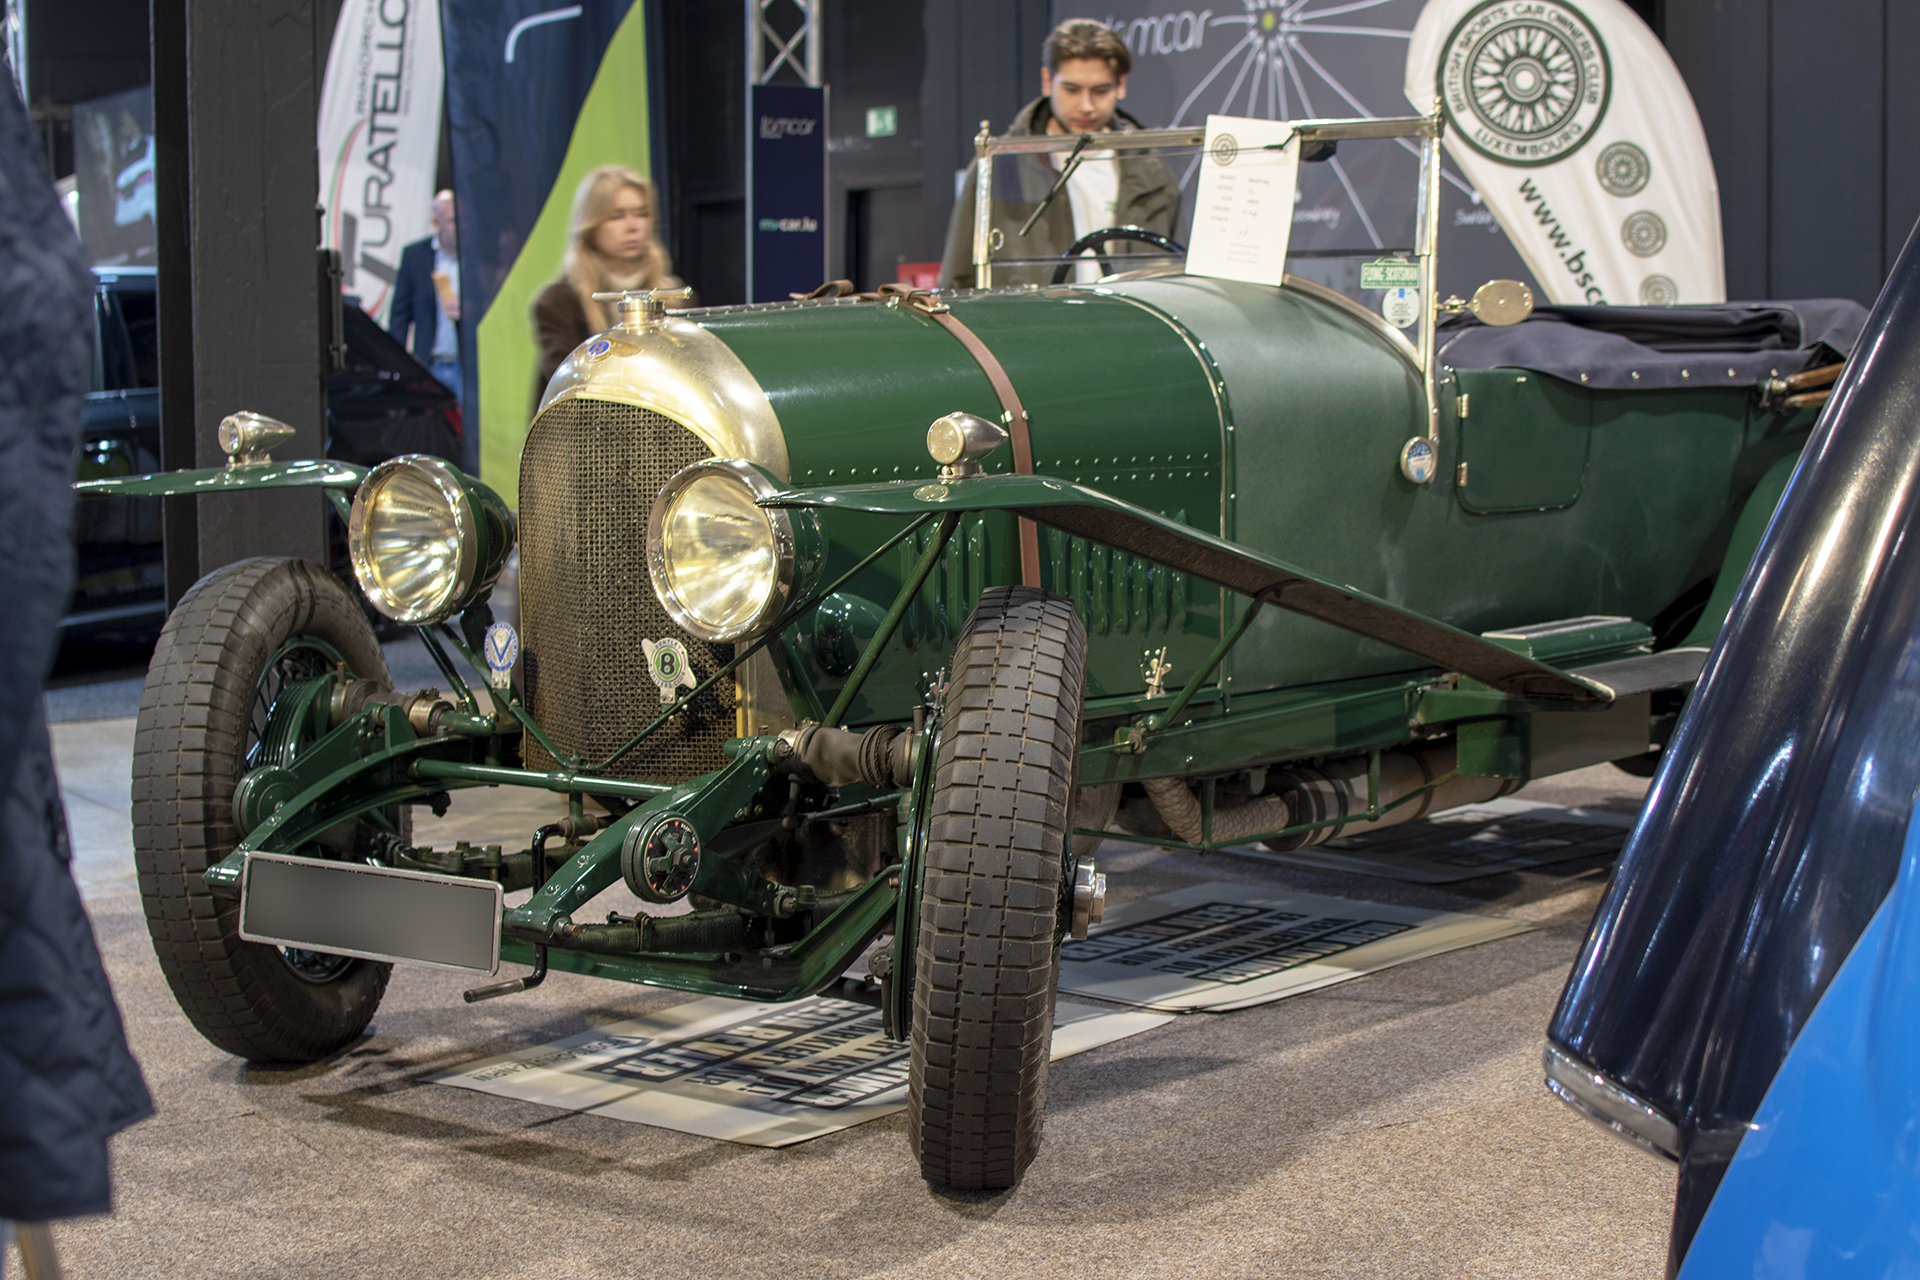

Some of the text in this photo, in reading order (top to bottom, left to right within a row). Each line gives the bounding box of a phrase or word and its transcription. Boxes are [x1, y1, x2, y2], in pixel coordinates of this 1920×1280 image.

[1447, 2, 1601, 114] BRITISH SPORTS CAR OWNERS CLUB
[1474, 122, 1584, 156] LUXEMBOURG
[655, 639, 681, 649] BENTLEY
[660, 652, 675, 675] B
[650, 670, 673, 688] DRIVERS
[1156, 904, 1265, 928] SEIN
[1104, 950, 1175, 966] NUR
[601, 999, 877, 1077] SEIN REVIER.
[748, 1018, 884, 1065] MARKIERT
[684, 1063, 769, 1086] NUR
[787, 1054, 875, 1077] KEIN
[790, 1056, 910, 1106] TIMER
